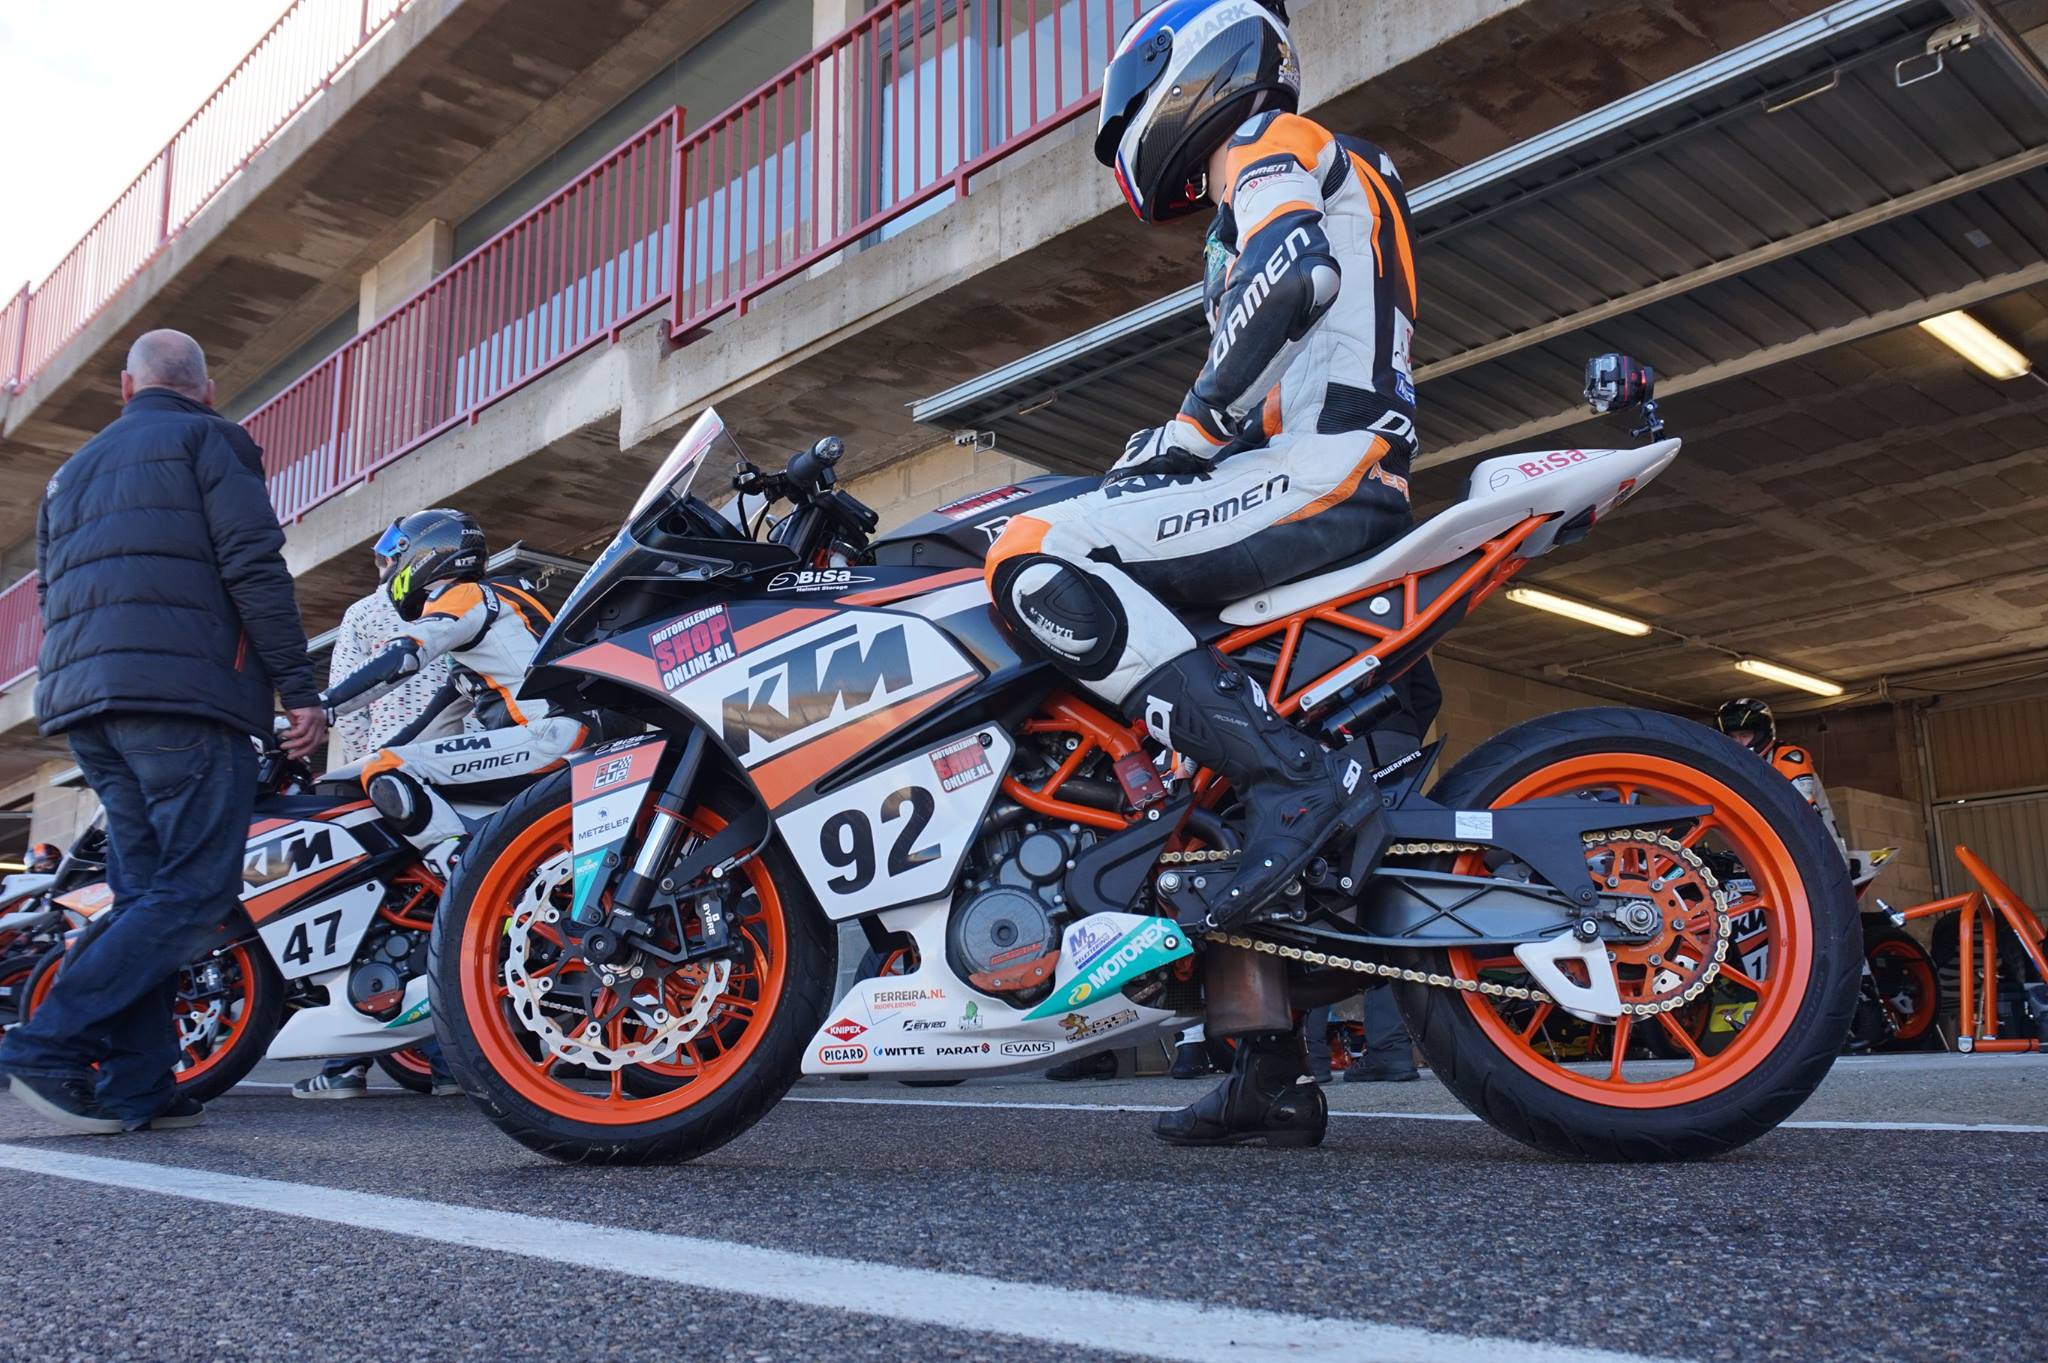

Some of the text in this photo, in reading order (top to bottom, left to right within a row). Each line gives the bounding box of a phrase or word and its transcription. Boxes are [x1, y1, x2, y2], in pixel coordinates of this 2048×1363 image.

[1213, 227, 1311, 370] DAMEN
[1518, 448, 1588, 479] BiSa
[1156, 474, 1290, 541] DAMEN
[799, 569, 851, 584] BiSa
[652, 604, 723, 645] MOTORKLEDING
[655, 614, 727, 672] SHOP
[663, 642, 735, 691] ONLINE.NL
[722, 623, 913, 752] KTM
[435, 736, 491, 754] KTM
[451, 751, 530, 776] DAMEN
[943, 763, 991, 791] ONLINE.NL
[1372, 750, 1421, 783] POWERPARTS
[594, 769, 628, 788] CUP
[579, 816, 629, 840] METZELER
[820, 785, 942, 895] 92
[282, 909, 343, 966] 47
[1087, 918, 1172, 990] MOTOREX
[874, 989, 946, 1002] FERREIRA.NL
[830, 1024, 861, 1035] KNIPEX
[824, 1048, 864, 1061] PICARD
[884, 1046, 925, 1056] WITTE
[1004, 1042, 1051, 1053] EVANS
